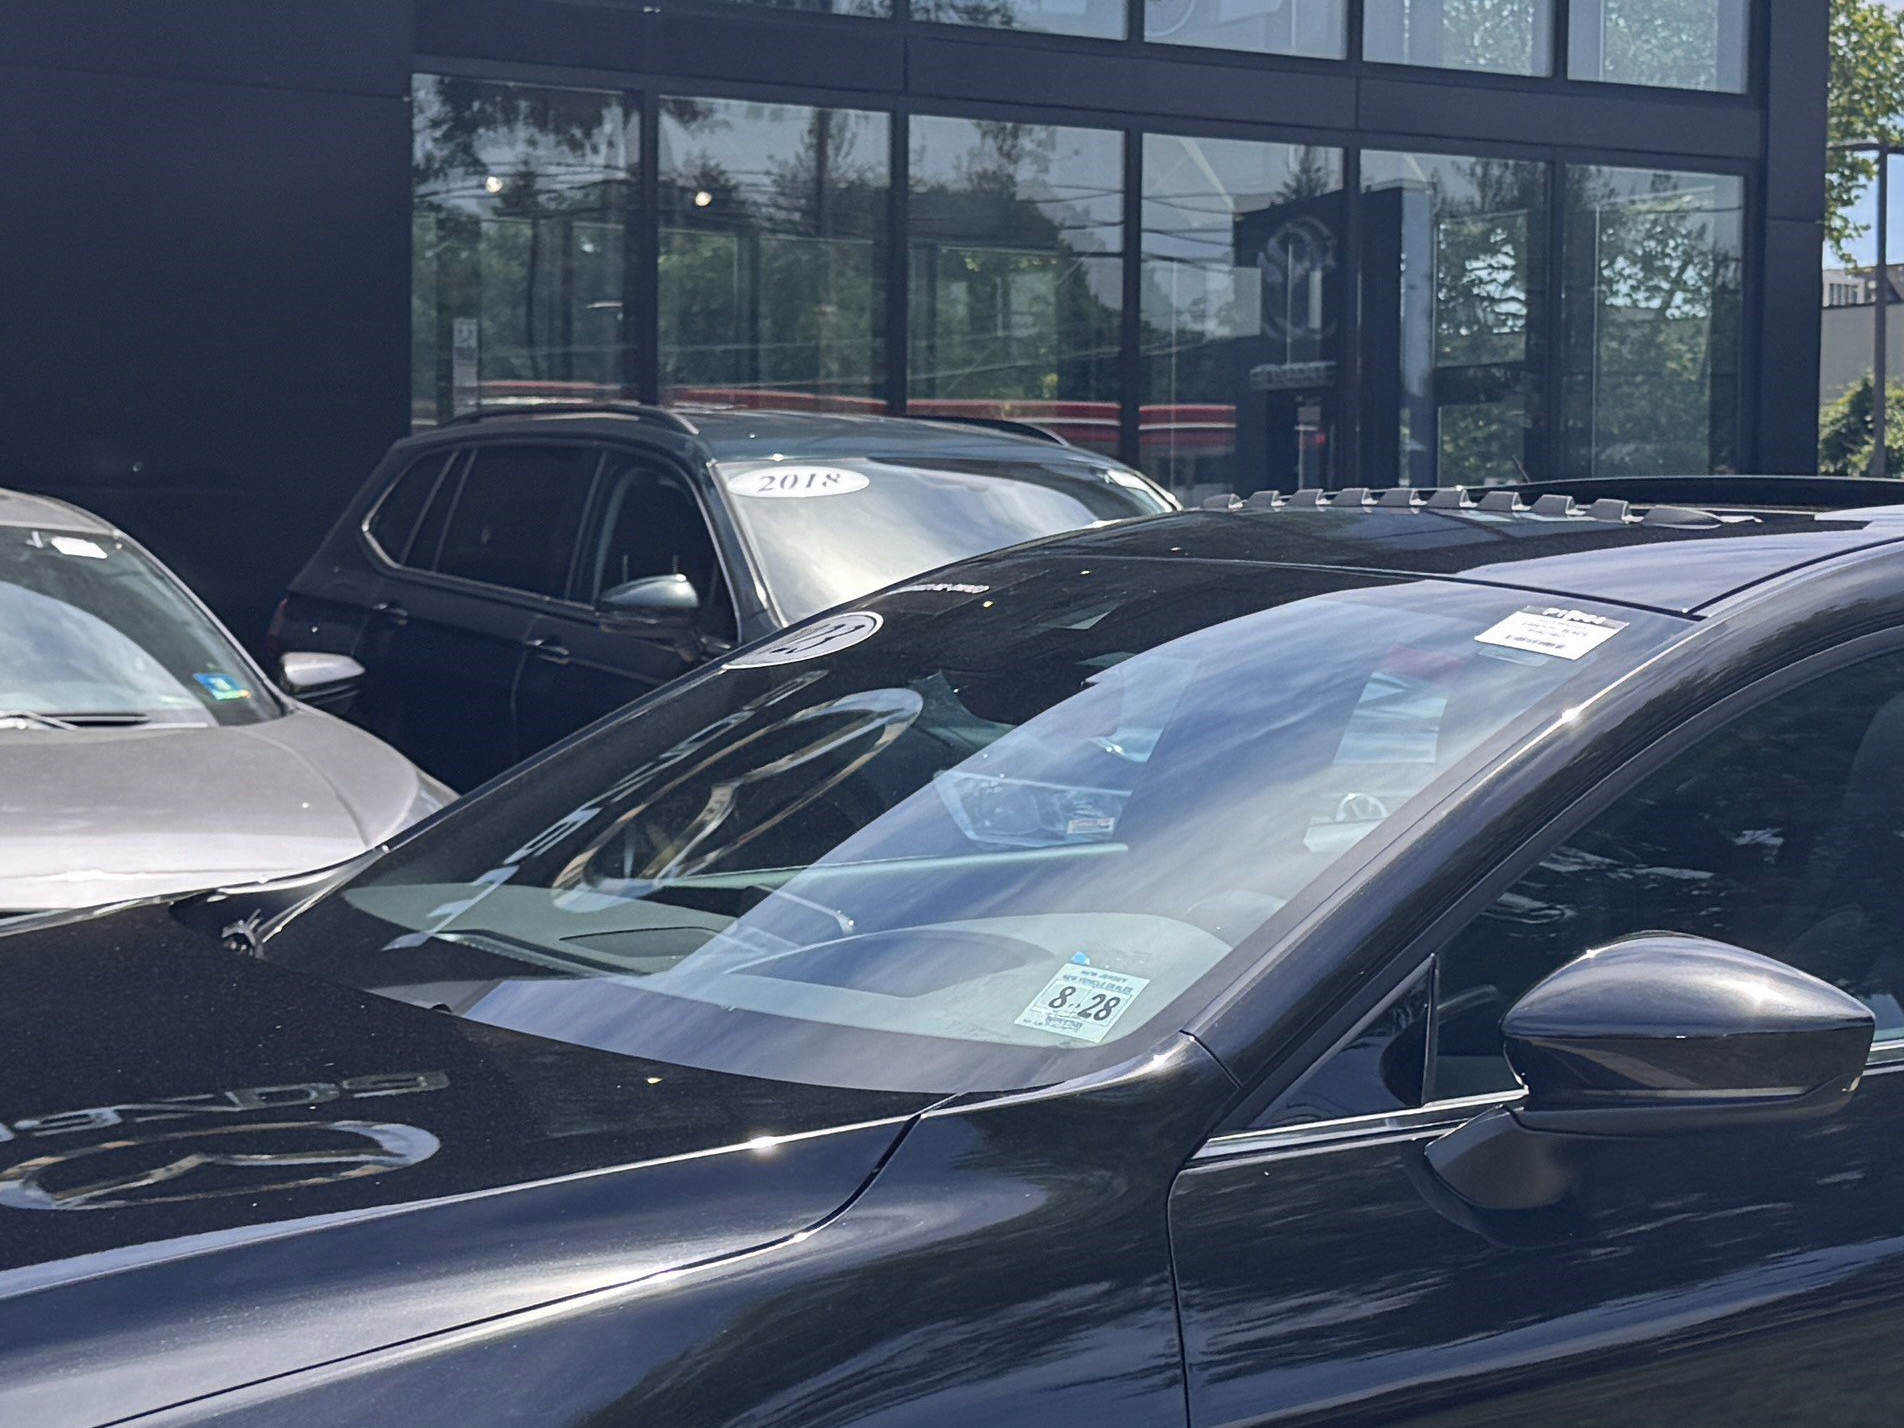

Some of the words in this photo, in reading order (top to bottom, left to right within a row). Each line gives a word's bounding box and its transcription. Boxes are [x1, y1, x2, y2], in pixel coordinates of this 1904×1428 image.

[756, 472, 842, 493] 2018
[1048, 986, 1077, 1009] 8
[1077, 993, 1121, 1021] 28
